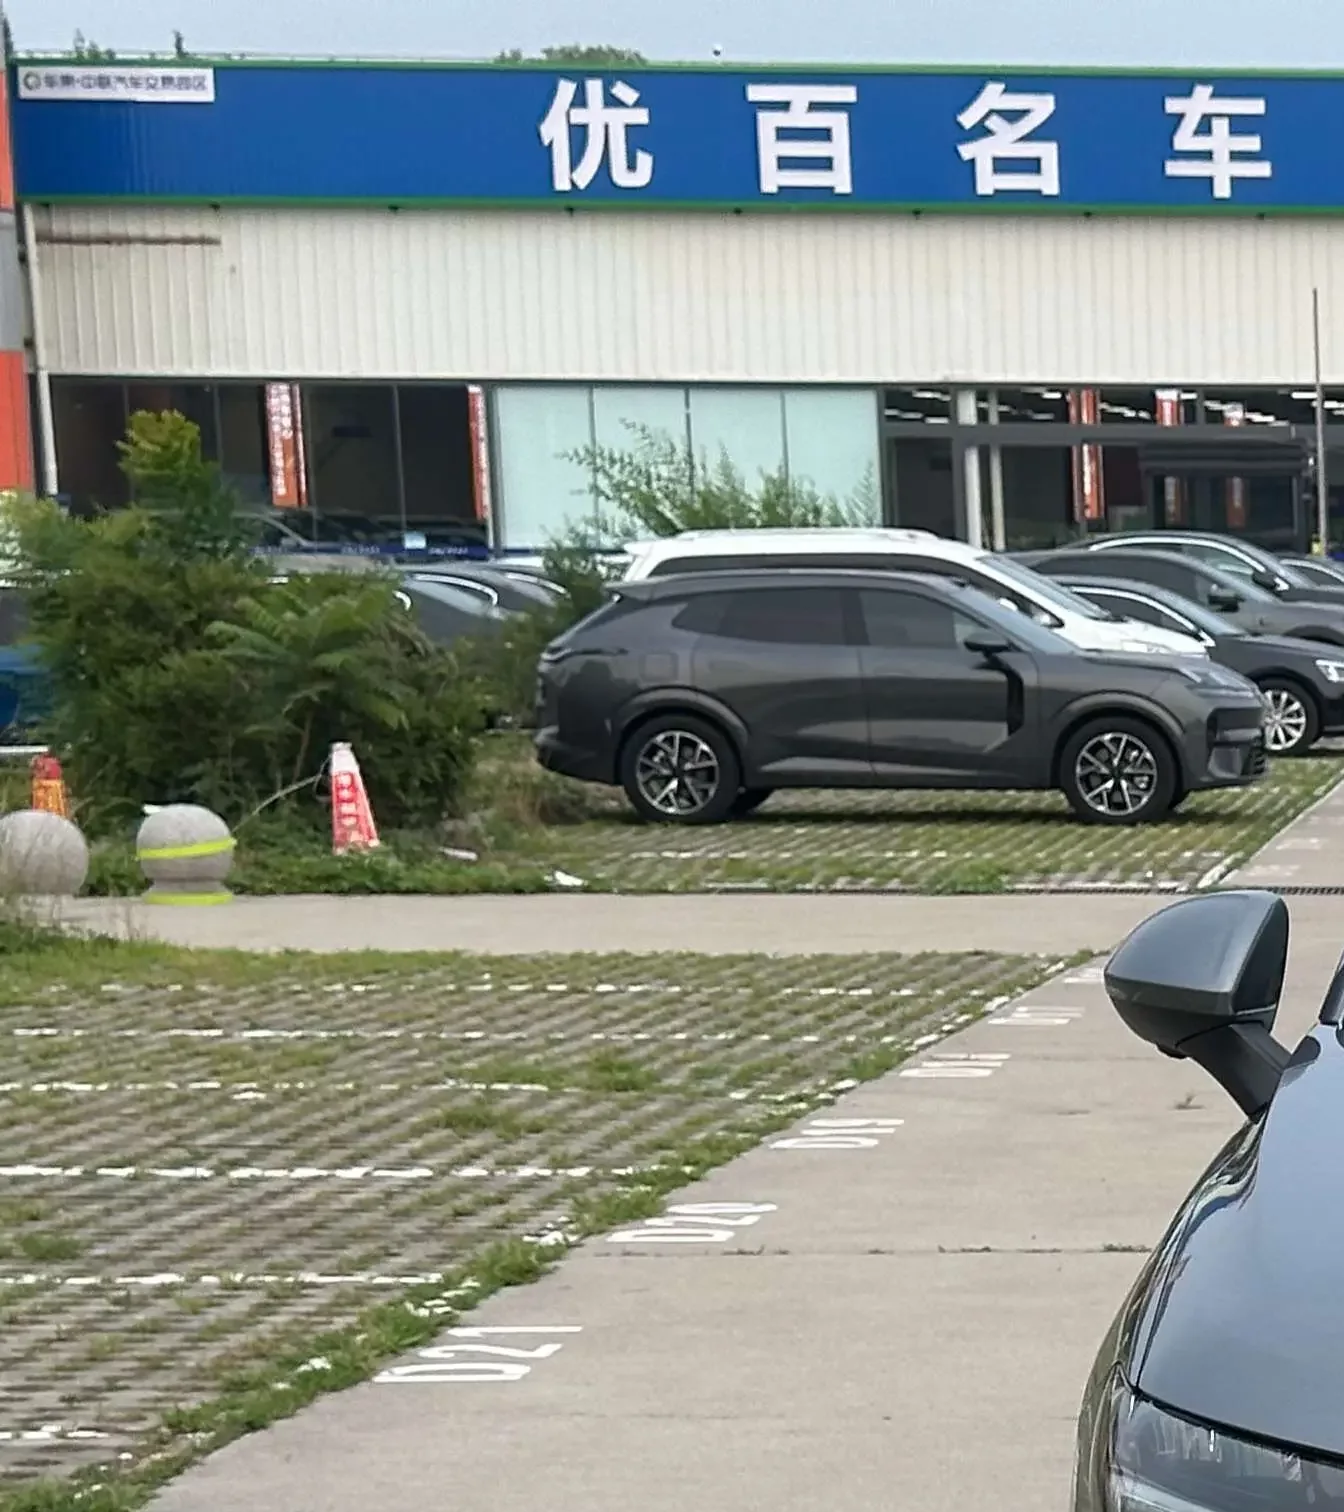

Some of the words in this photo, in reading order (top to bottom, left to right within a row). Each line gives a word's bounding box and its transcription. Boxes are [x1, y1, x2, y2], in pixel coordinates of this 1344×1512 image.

[539, 78, 1273, 200] 优百名车
[769, 1117, 905, 1150] D19
[604, 1201, 779, 1243] D20
[372, 1325, 584, 1384] D21
